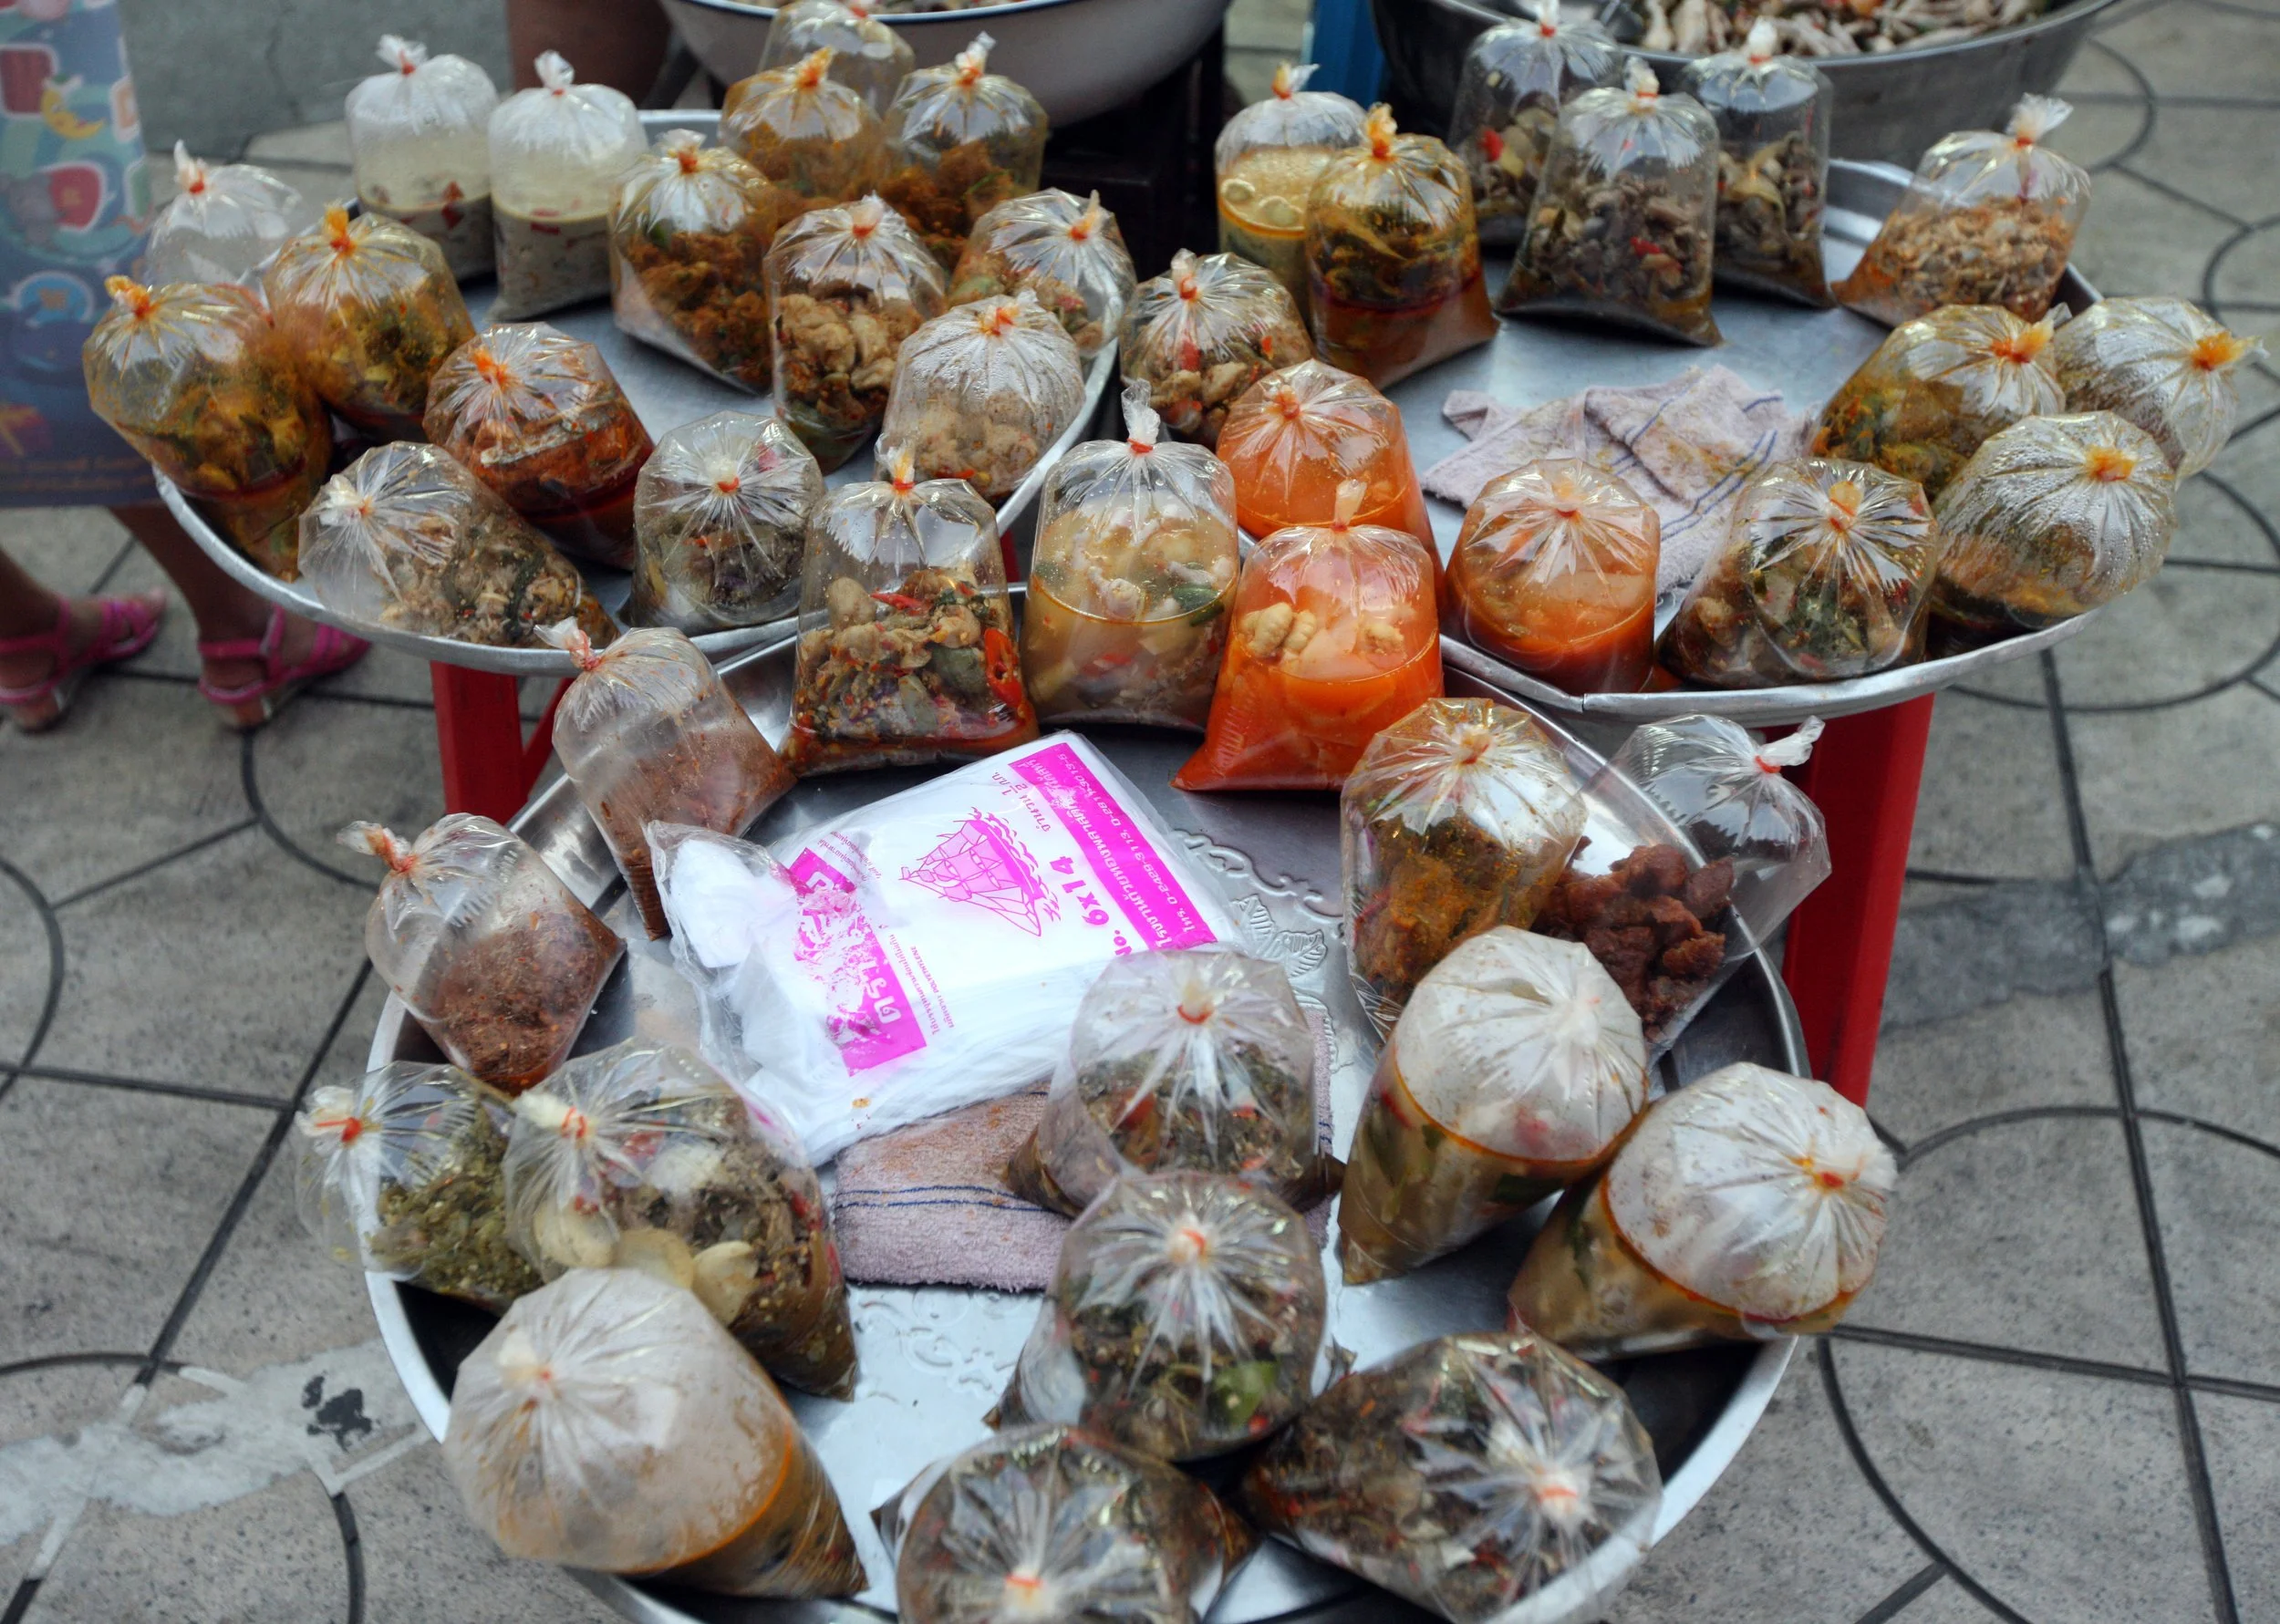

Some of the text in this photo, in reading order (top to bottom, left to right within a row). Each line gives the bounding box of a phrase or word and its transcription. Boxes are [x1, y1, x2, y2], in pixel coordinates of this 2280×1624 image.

[1019, 794, 1051, 833] จำนวน
[1049, 853, 1110, 926] 6x14
[1119, 829, 1176, 905] 0-2429-3113,
[1176, 906, 1195, 933] โทร.
[910, 946, 939, 993] POLYETHYLENE
